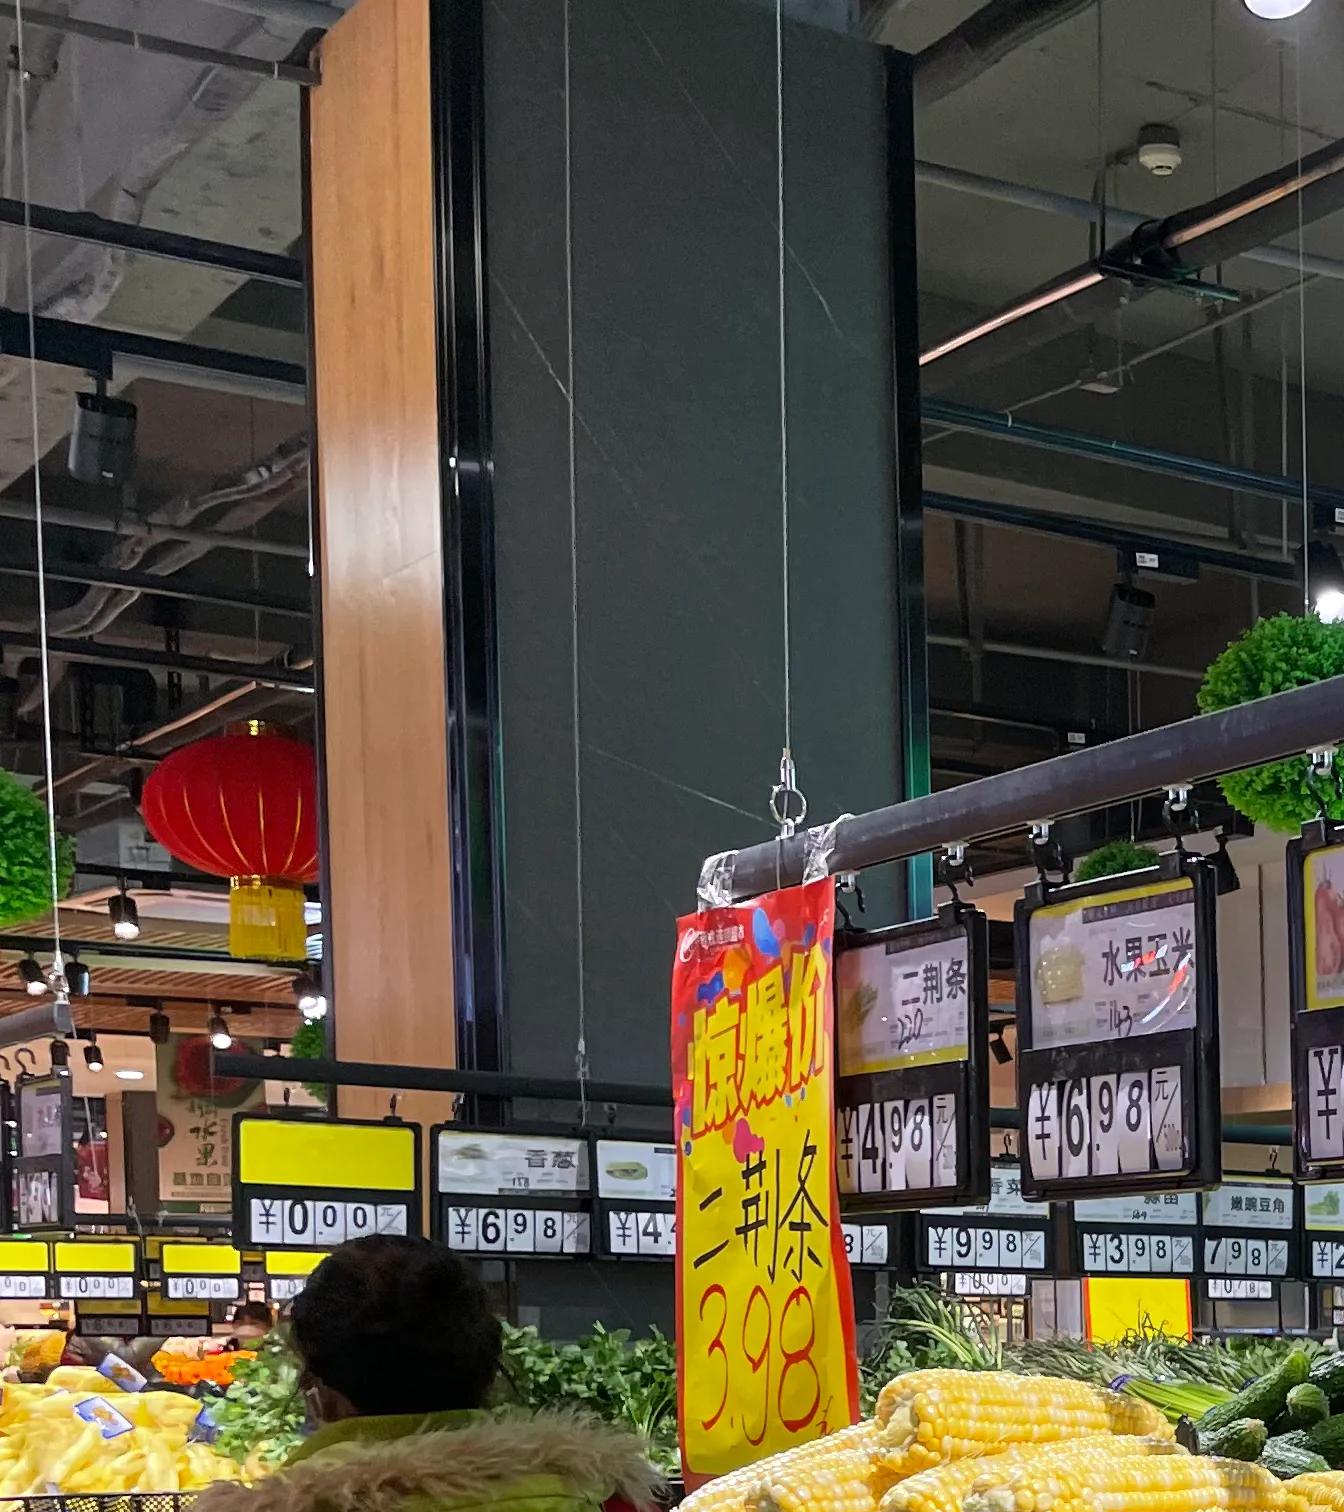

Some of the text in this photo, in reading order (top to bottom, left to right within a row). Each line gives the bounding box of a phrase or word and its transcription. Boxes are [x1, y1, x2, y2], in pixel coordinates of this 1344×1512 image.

[901, 957, 967, 1007] 二荆条
[1102, 927, 1194, 987] 水果玉米
[688, 942, 827, 1142] 惊爆价
[840, 1103, 925, 1177] ¥4.98
[1034, 1078, 1143, 1161] ¥6.98
[256, 1199, 368, 1237] ¥0.00
[452, 1208, 557, 1244] ¥6.98
[693, 1129, 830, 1284] 二荆条
[933, 1226, 1017, 1259] ¥9.98
[1087, 1232, 1168, 1265] ¥3.98
